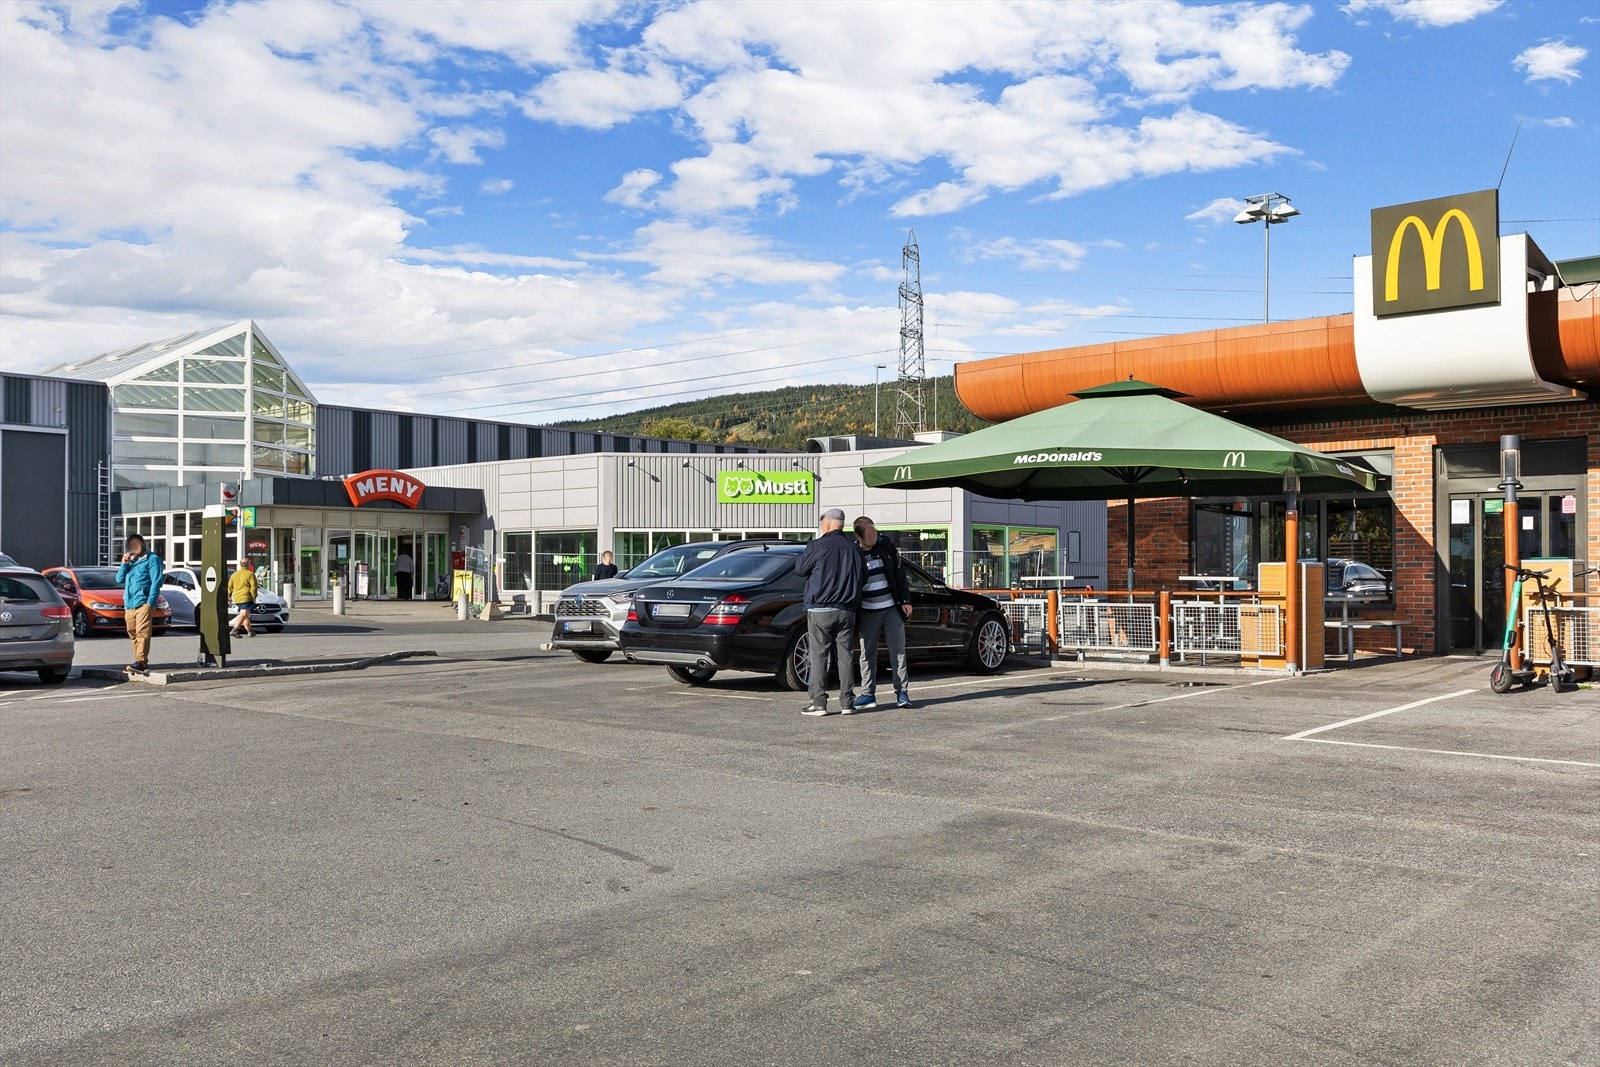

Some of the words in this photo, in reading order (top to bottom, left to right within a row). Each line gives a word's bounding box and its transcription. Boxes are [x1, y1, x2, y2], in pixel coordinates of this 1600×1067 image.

[1013, 451, 1103, 465] McDonald's
[356, 476, 419, 498] MENY
[755, 479, 808, 494] Musti
[563, 555, 582, 564] Musti
